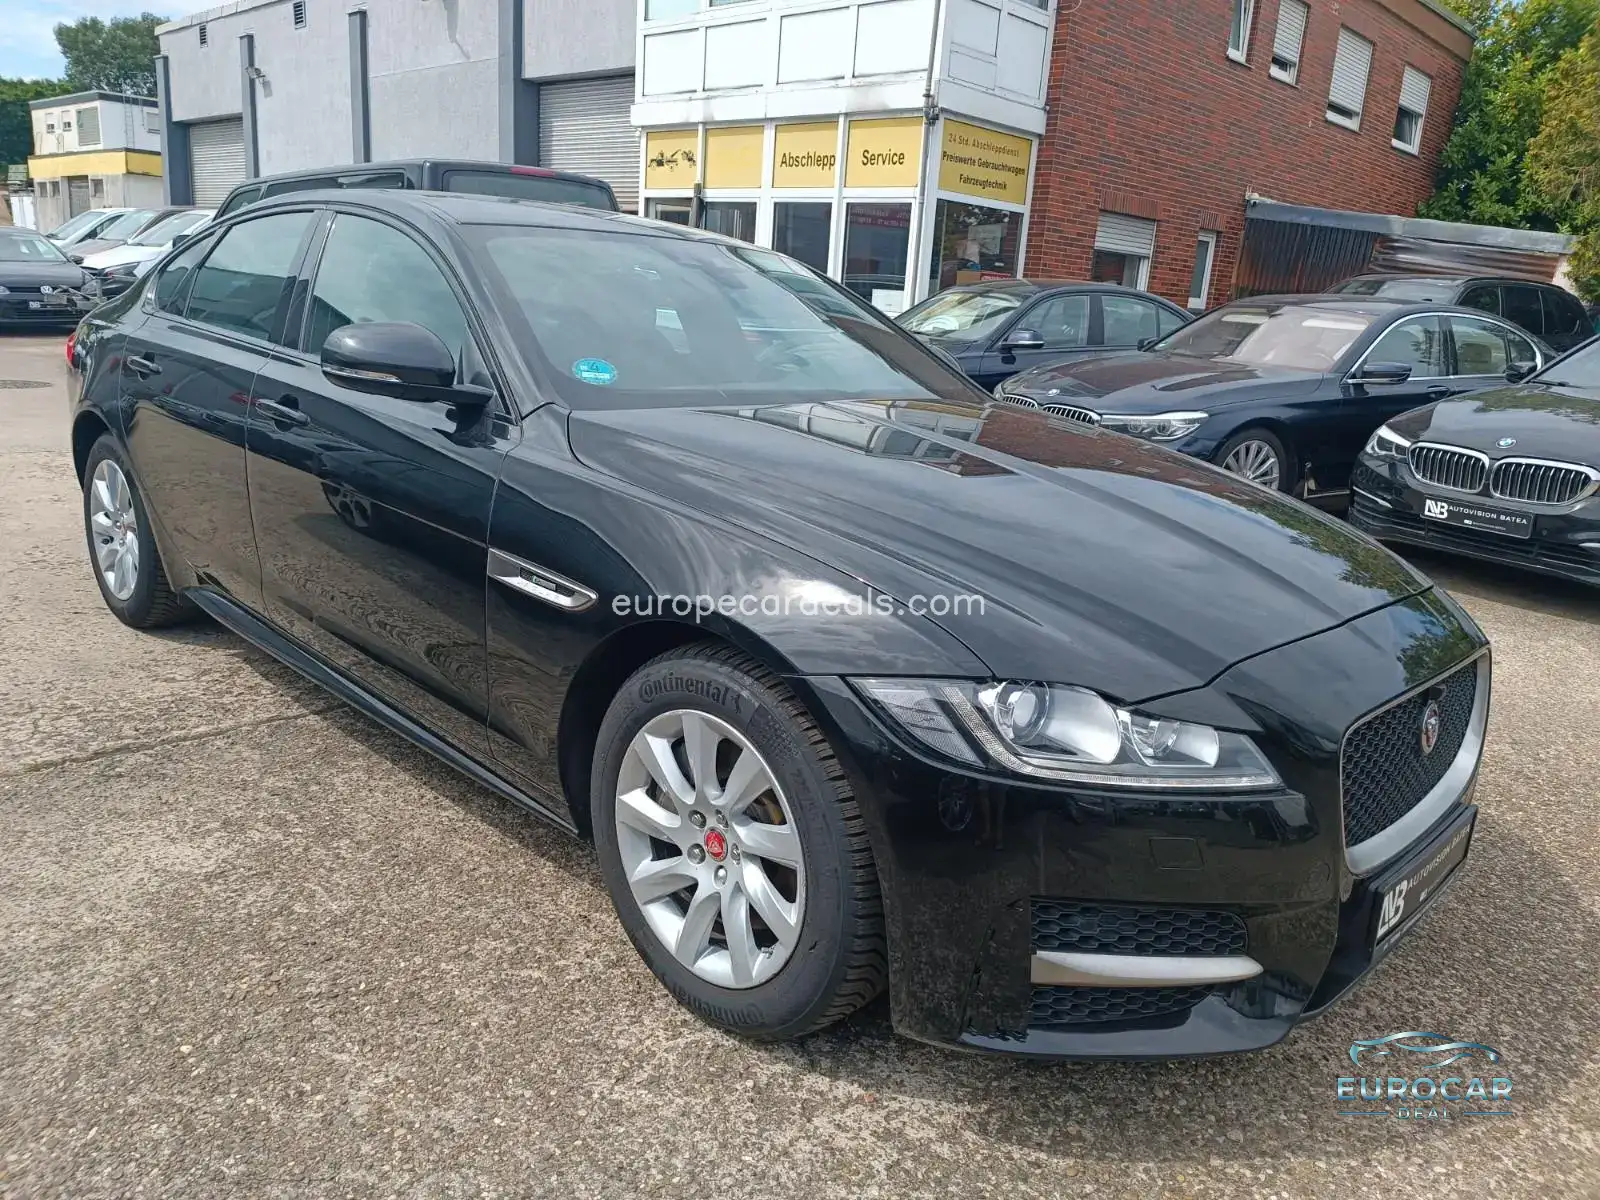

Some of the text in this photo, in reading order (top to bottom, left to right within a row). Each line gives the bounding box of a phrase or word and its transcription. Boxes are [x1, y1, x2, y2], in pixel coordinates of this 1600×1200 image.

[948, 133, 1020, 158] 24 Std. Abschleppdienst
[780, 148, 906, 171] Abschlepp Service
[942, 151, 1026, 177] Preiswerte Gebrauchtwagen
[959, 173, 1008, 190] Fahrzeugtechnik
[1449, 505, 1497, 519] AUTOVISION
[1499, 515, 1528, 525] BATEA
[639, 671, 730, 707] Continental
